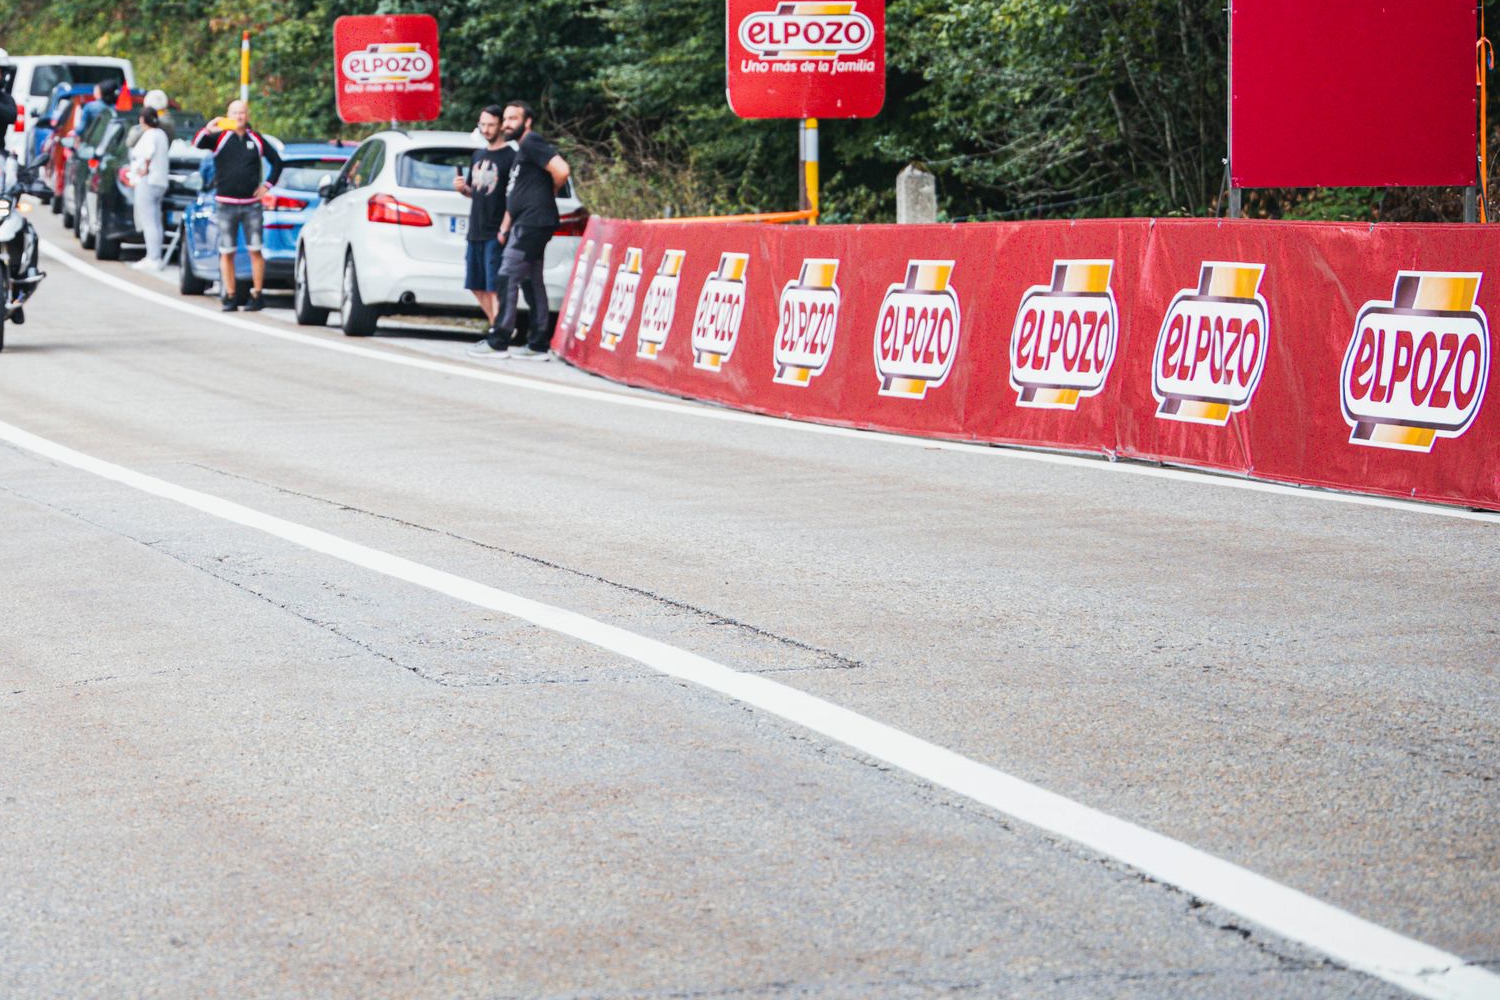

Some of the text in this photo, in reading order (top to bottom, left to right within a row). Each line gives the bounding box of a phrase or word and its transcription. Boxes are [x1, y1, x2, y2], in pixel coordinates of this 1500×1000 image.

[740, 59, 875, 76] Uno más de la familia
